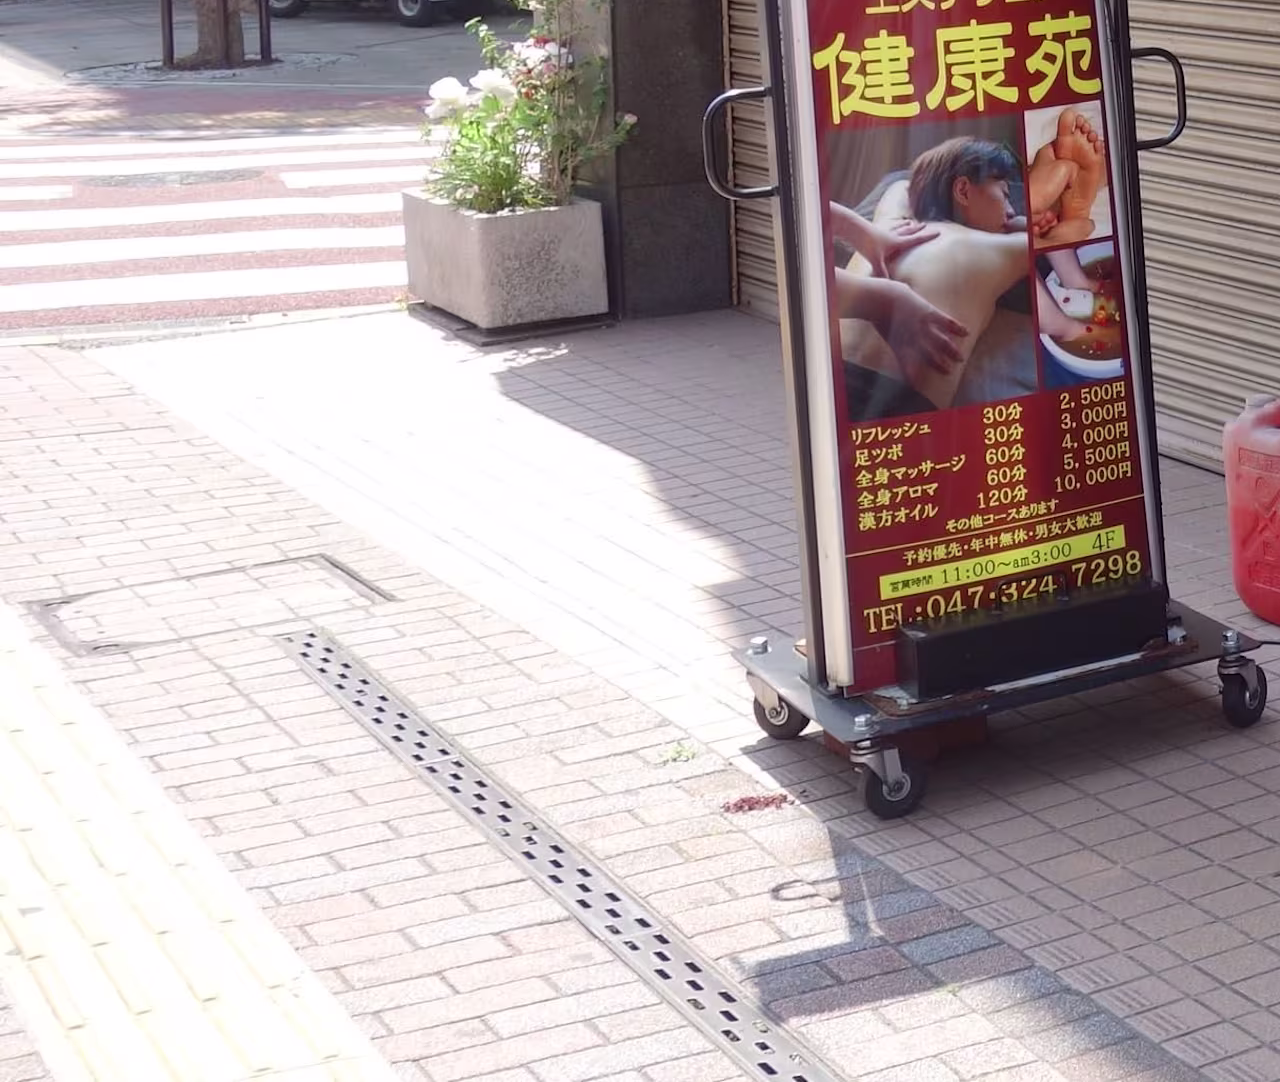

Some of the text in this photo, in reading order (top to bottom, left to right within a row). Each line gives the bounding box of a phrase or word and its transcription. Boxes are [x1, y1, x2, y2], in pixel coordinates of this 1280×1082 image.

[812, 10, 1103, 125] 健康苑
[851, 421, 932, 446] リフレッシュ
[982, 402, 1023, 424] 30分
[854, 443, 904, 468] 足ツボ
[984, 422, 1025, 445] 30分
[855, 453, 967, 488] 全身マッサージ
[985, 443, 1026, 465] 60分
[857, 482, 939, 510] 全身アロマ
[986, 464, 1027, 486] 60分
[858, 502, 939, 531] 漢方オイル
[977, 484, 1028, 509] 120分
[945, 498, 1060, 533] その他コースあります
[1092, 530, 1116, 553] 4F
